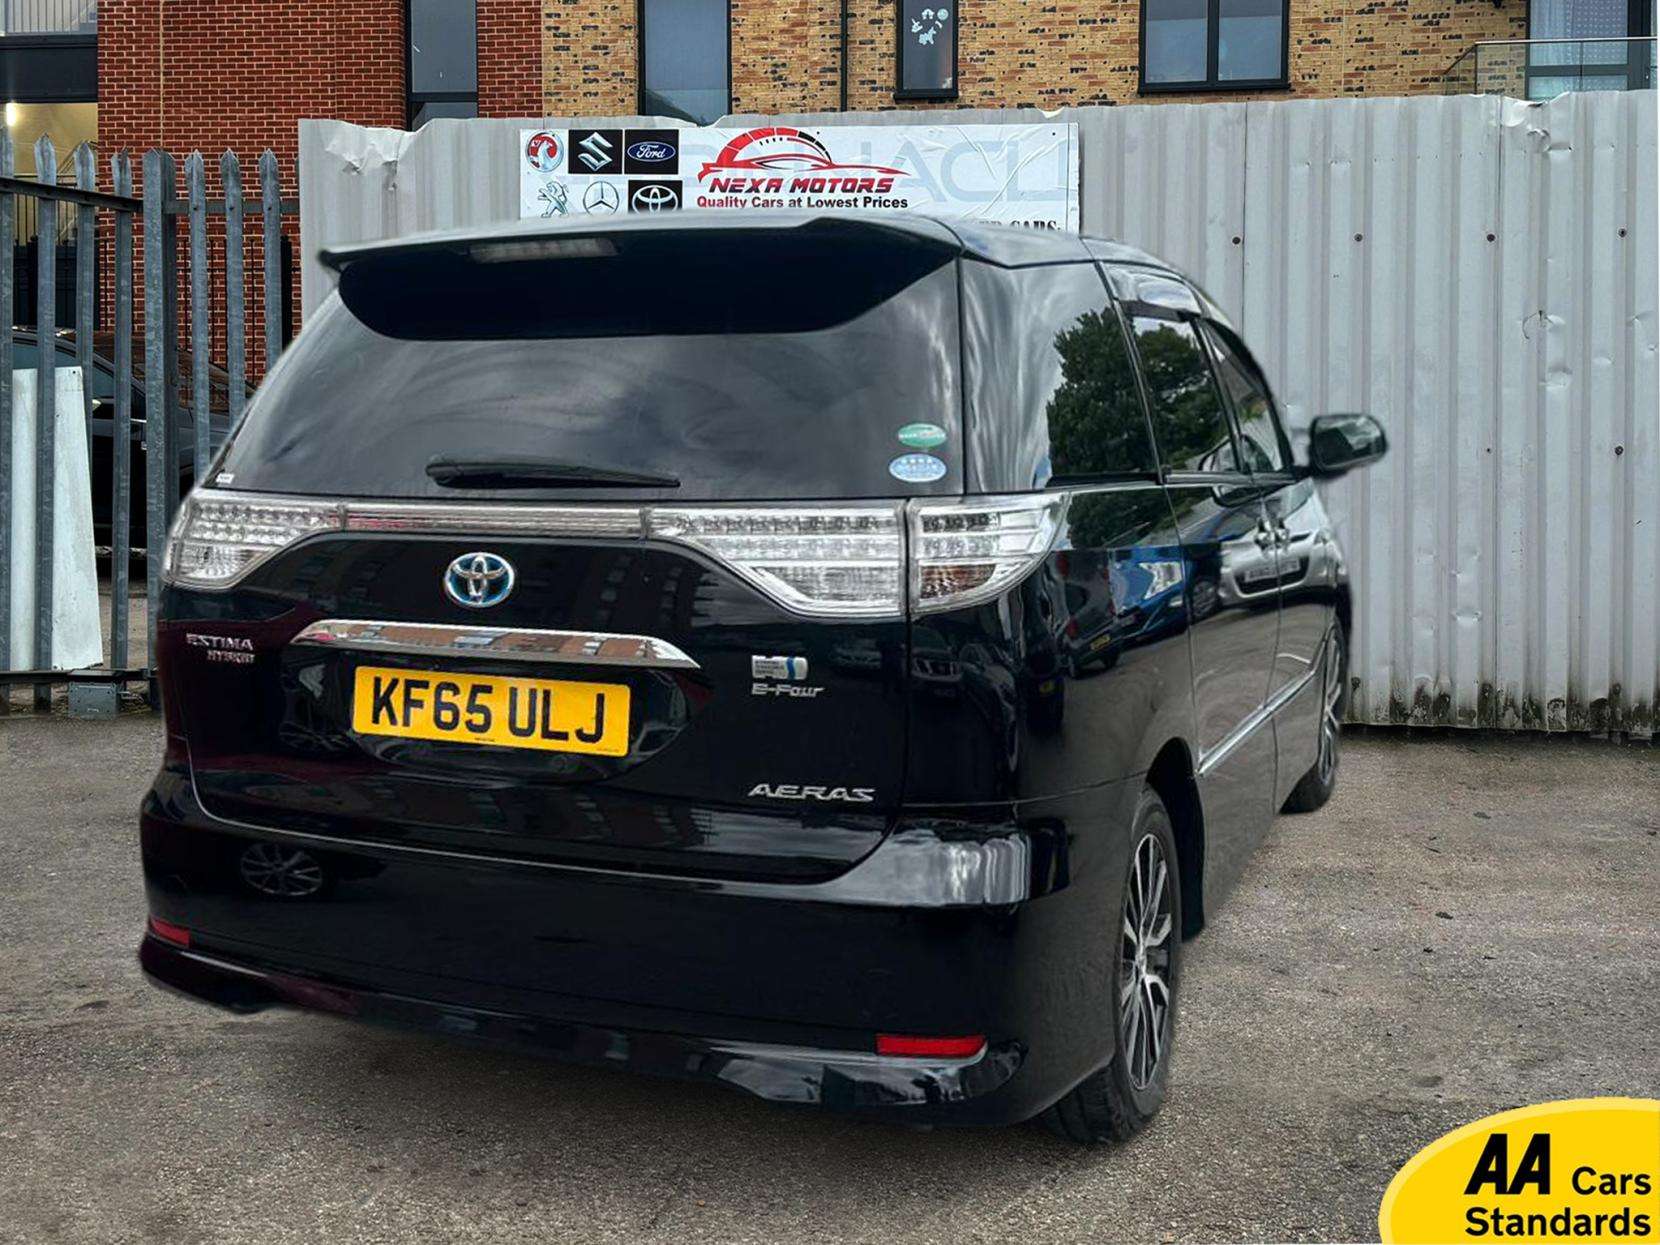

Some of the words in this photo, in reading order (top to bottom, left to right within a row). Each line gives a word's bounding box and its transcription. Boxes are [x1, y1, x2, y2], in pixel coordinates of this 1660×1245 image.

[636, 144, 666, 158] Ford
[708, 177, 784, 193] NEXA
[788, 177, 895, 194] MOTORS
[697, 195, 747, 208] Quality
[751, 196, 784, 208] Cars
[788, 197, 803, 208] at
[806, 196, 858, 208] Lowest
[863, 196, 908, 208] Prices
[186, 632, 254, 651] ESTIMA
[371, 675, 494, 734] KF65
[508, 686, 605, 744] ULJ
[747, 783, 876, 802] AERAS
